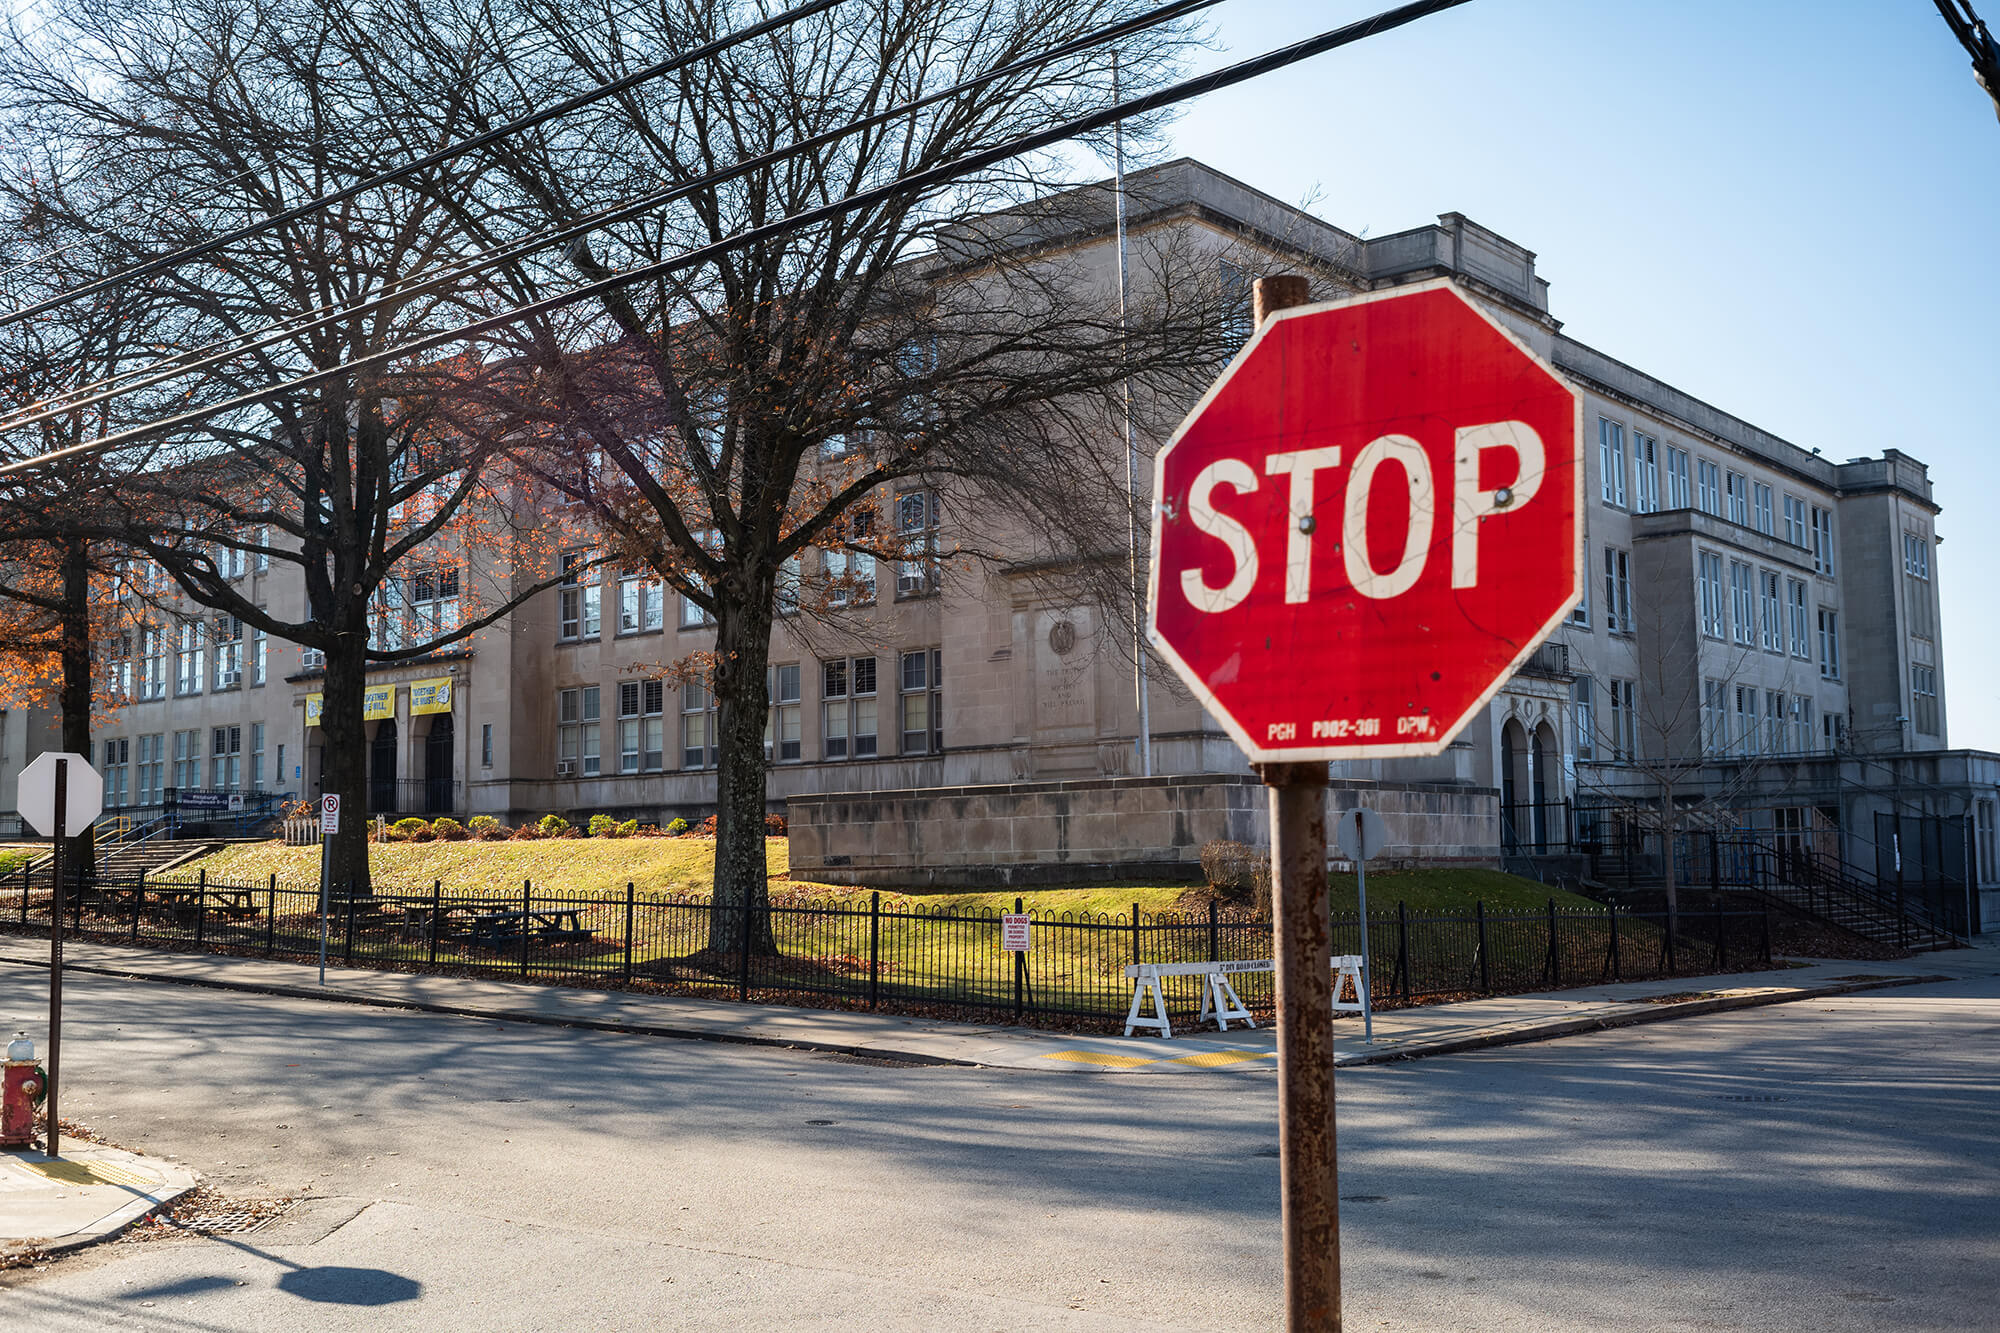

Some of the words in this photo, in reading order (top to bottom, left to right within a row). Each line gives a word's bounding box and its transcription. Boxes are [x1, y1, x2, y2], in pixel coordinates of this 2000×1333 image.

[1180, 420, 1546, 613] STOP
[412, 687, 435, 696] TOGETHER
[1268, 723, 1296, 741] PGH
[1251, 961, 1270, 969] CLOSED
